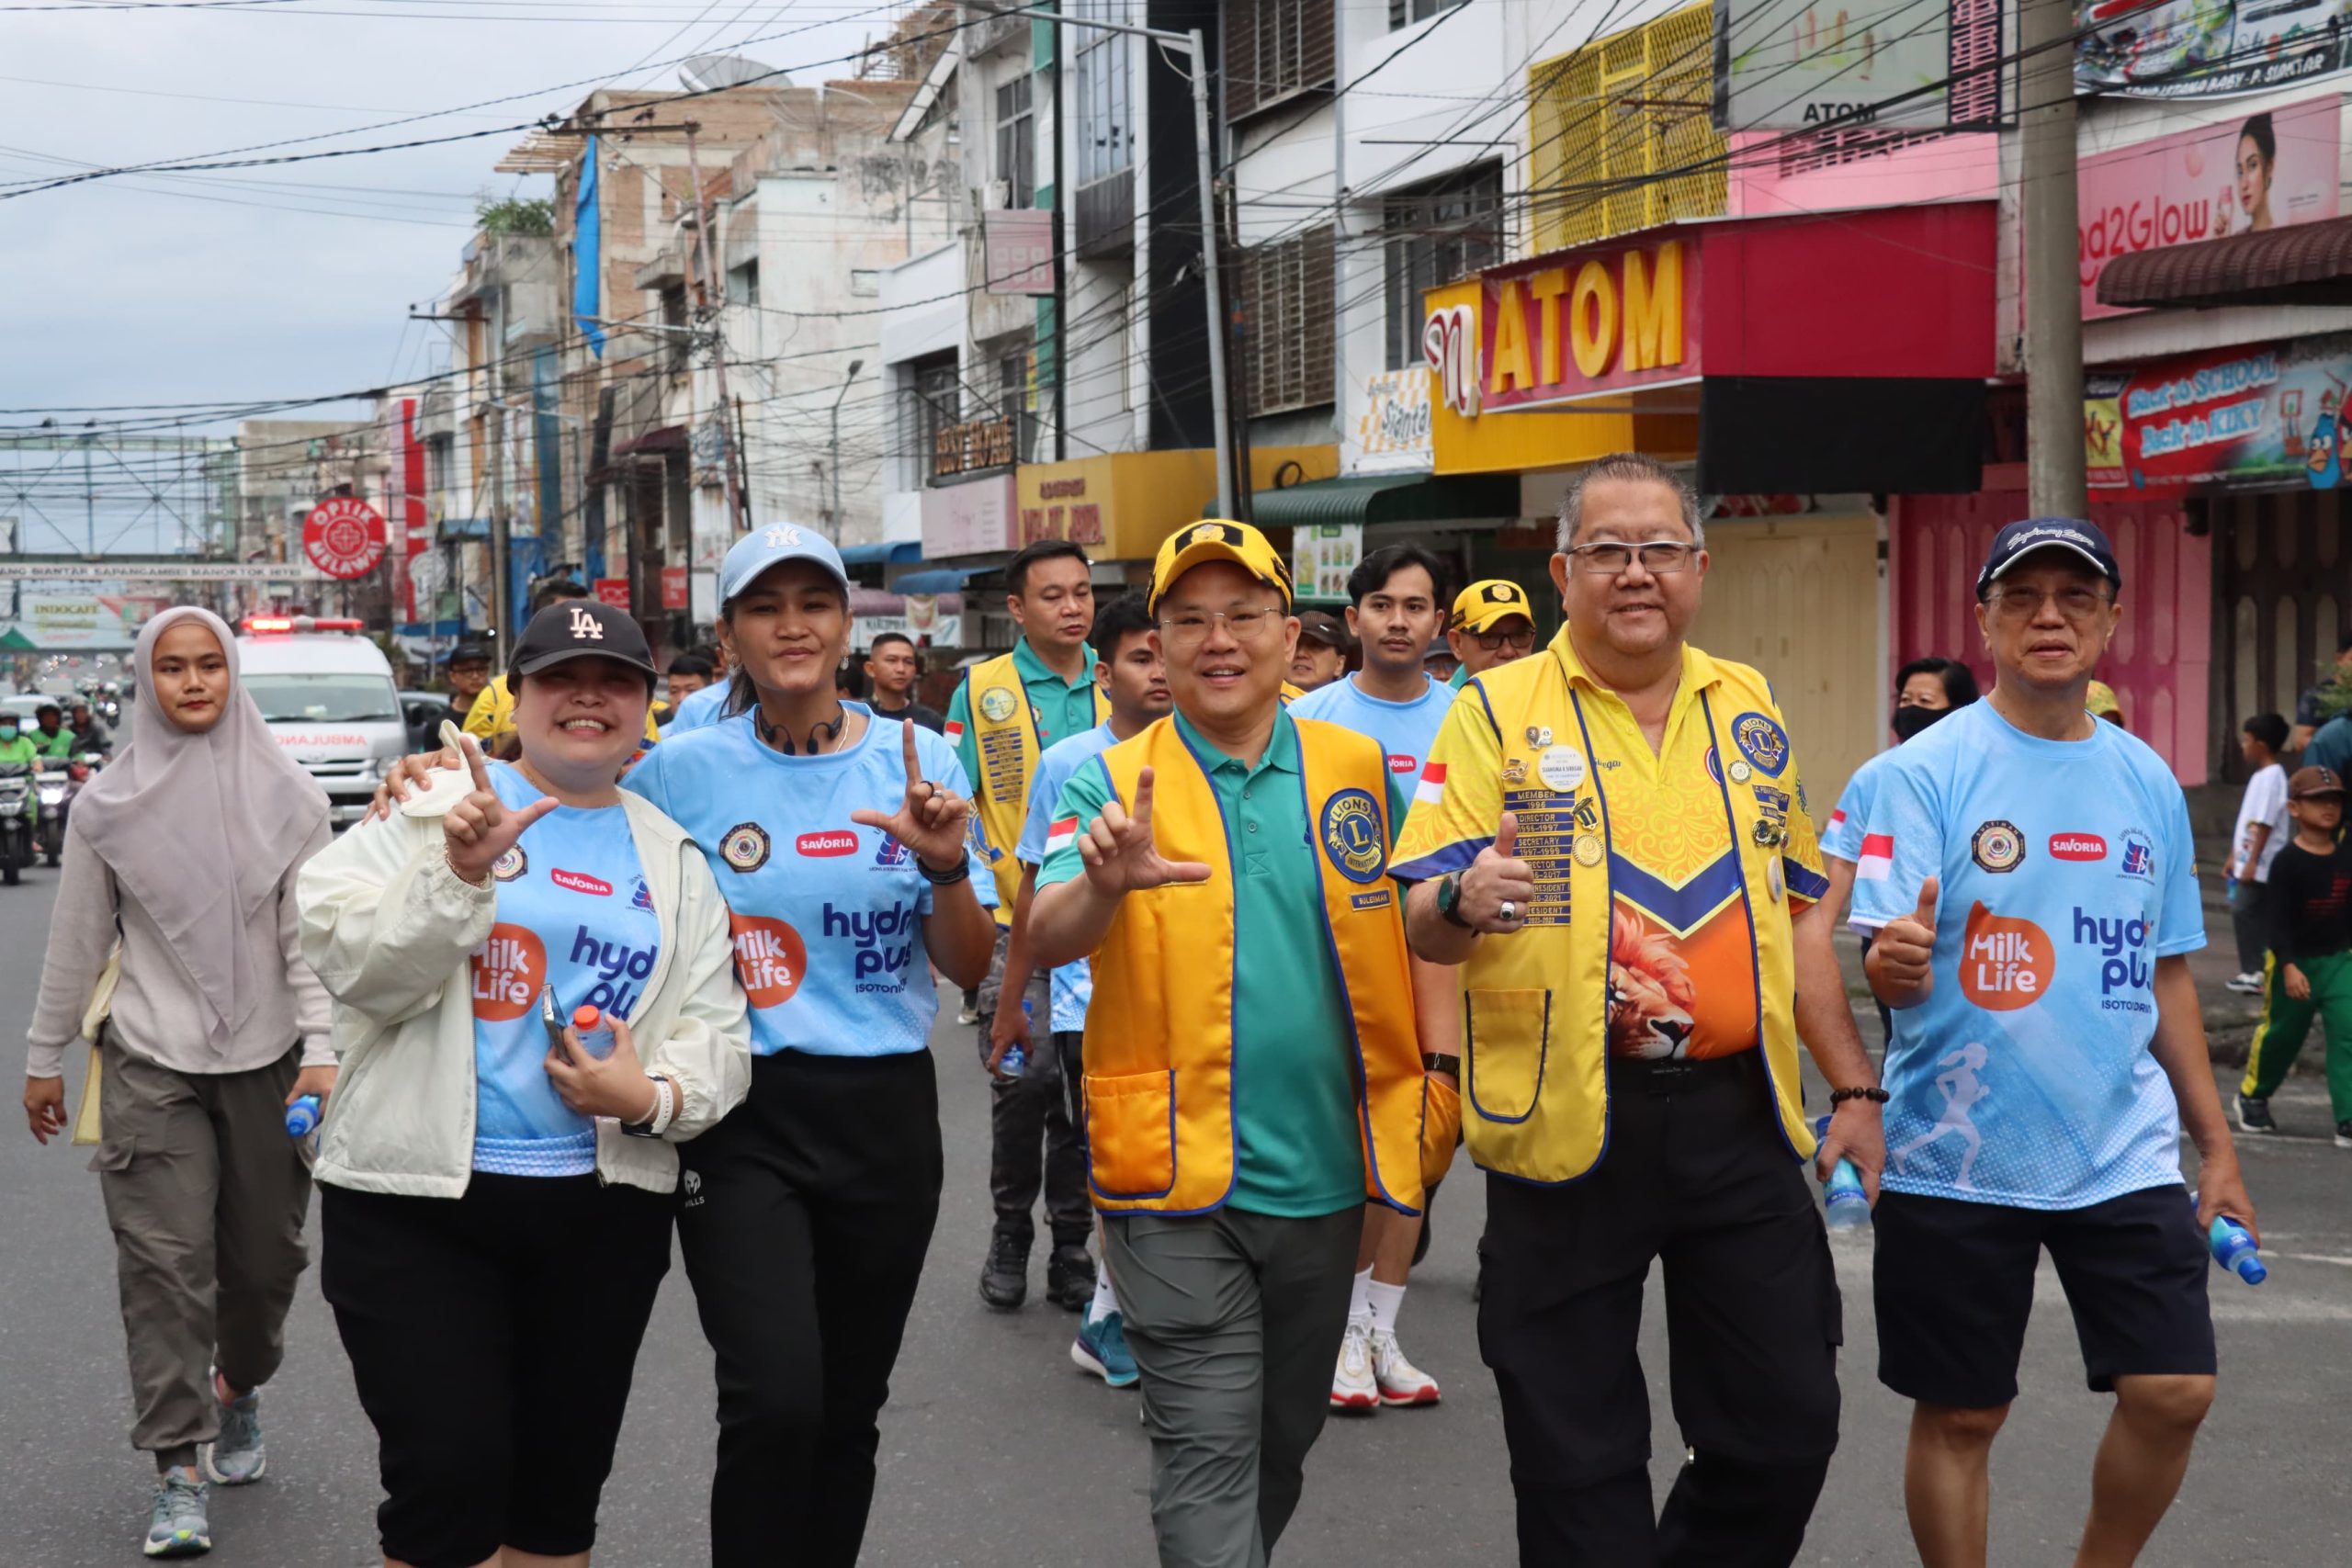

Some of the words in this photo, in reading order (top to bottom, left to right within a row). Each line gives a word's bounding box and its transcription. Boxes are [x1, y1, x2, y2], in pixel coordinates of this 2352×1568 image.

[1804, 102, 1877, 122] ATOM
[1489, 242, 1683, 395] ATOM
[2194, 353, 2279, 402] SCHOOL
[2205, 397, 2265, 442] KIKY
[312, 500, 377, 525] OPTIK
[309, 539, 383, 574] MELAWAI
[35, 603, 102, 615] INDOCAFE
[570, 608, 604, 639] LA
[1744, 717, 1772, 731] LIONS
[1388, 758, 1414, 768] VORIA
[1517, 791, 1556, 800] MEMBER
[1332, 798, 1369, 818] LIONS
[1519, 814, 1555, 823] DIRECTOR
[800, 836, 854, 850] SAVORIA
[1347, 819, 1370, 847] L
[1518, 837, 1560, 847] SECRETARY
[2052, 838, 2103, 852] SAVORIA
[1528, 860, 1555, 869] RECTOR
[554, 873, 609, 893] SAVORIA
[1534, 884, 1566, 893] RESIDENT
[1358, 894, 1388, 906] SULEIMAN
[1528, 907, 1564, 915] ESIDENT
[570, 924, 658, 981] hyd
[1970, 932, 2034, 964] Milk
[741, 958, 792, 991] Life
[1977, 962, 2037, 992] Life
[473, 968, 530, 1006] Life
